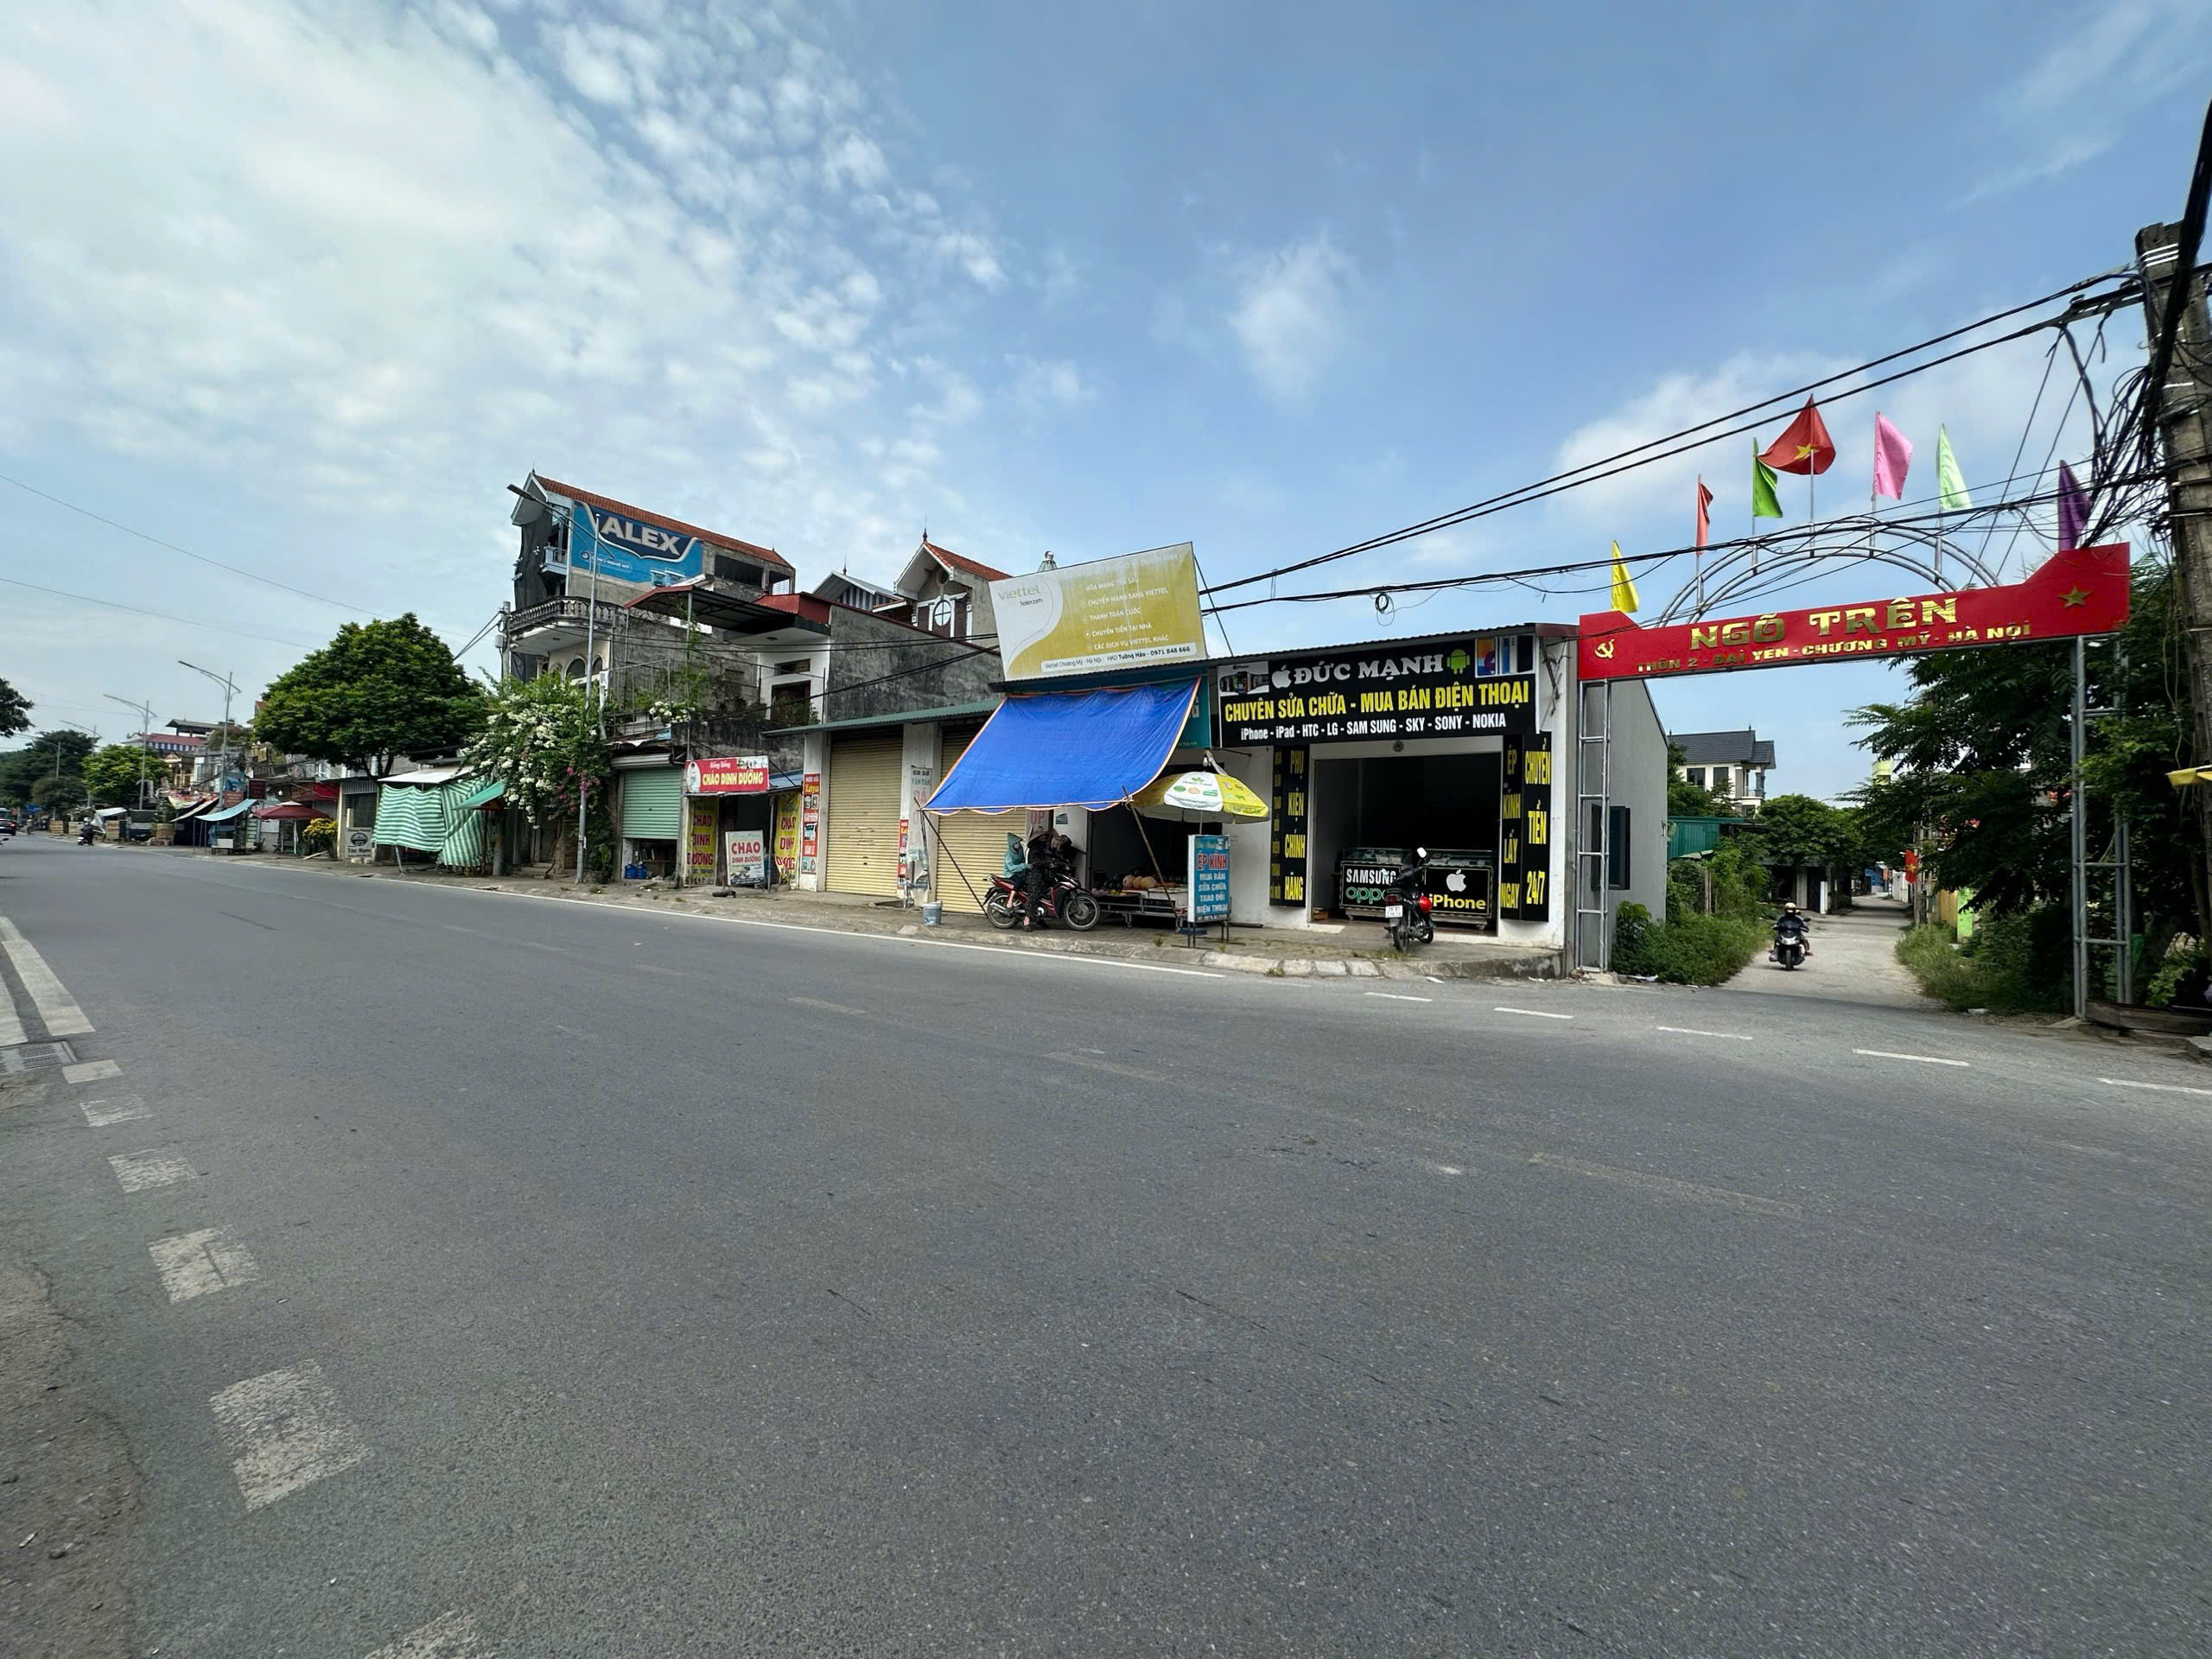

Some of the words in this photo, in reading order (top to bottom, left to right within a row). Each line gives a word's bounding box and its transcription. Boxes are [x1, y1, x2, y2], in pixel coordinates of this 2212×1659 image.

[601, 517, 681, 556] ALEX
[997, 585, 1042, 601] viettel
[1020, 598, 1043, 607] telecom
[1145, 588, 1169, 596] VIETTEL
[1089, 613, 1109, 621] THANH
[1690, 613, 1785, 650] NGÕ
[1809, 597, 1957, 636] TRÊN
[1094, 640, 1105, 651] CÁC
[1129, 636, 1152, 645] VIETTEL
[1637, 658, 1681, 672] THÔN
[1688, 658, 1699, 667] 2
[1802, 639, 1888, 656] CHƯƠNG
[1897, 631, 1931, 647] MỸ
[1948, 626, 1980, 642] HÀ
[1986, 620, 2031, 640] NỘI
[1294, 661, 1351, 684] ĐỨC
[1357, 654, 1445, 681] MẠNH
[1224, 697, 1274, 722] CHUYÊN
[1278, 692, 1306, 718] SỬA
[1308, 691, 1347, 717] CHỮA
[1360, 690, 1395, 713] MUA
[1398, 684, 1431, 710] BÁN
[1434, 681, 1474, 712] ĐIỆN
[1478, 680, 1529, 709] THOẠI
[1241, 728, 1268, 741] iPhone
[1275, 726, 1295, 739] iPad
[1302, 723, 1319, 737] HTC
[1326, 722, 1338, 735] LG
[1346, 721, 1368, 734] SAM
[1370, 719, 1396, 734] SUNG
[1405, 717, 1425, 732] SKY
[1434, 715, 1463, 731] SONY
[1472, 713, 1506, 728] NOKIA
[1290, 750, 1304, 780] PHỤ
[1525, 737, 1551, 785] CHUYỂN
[702, 770, 720, 785] CHÁO
[721, 772, 737, 785] DINH
[738, 769, 764, 785] DƯỠNG
[1287, 787, 1304, 822] KIỆN
[1503, 789, 1521, 819] KÍNH
[1285, 830, 1306, 858] CHÍNH
[1504, 830, 1519, 863] LẤY
[1284, 871, 1303, 900] HÀNG
[1346, 868, 1397, 885] SAMSUNG
[1526, 870, 1546, 906] 24/7
[1428, 893, 1486, 910] iPhone
[1500, 882, 1520, 909] NGAY
